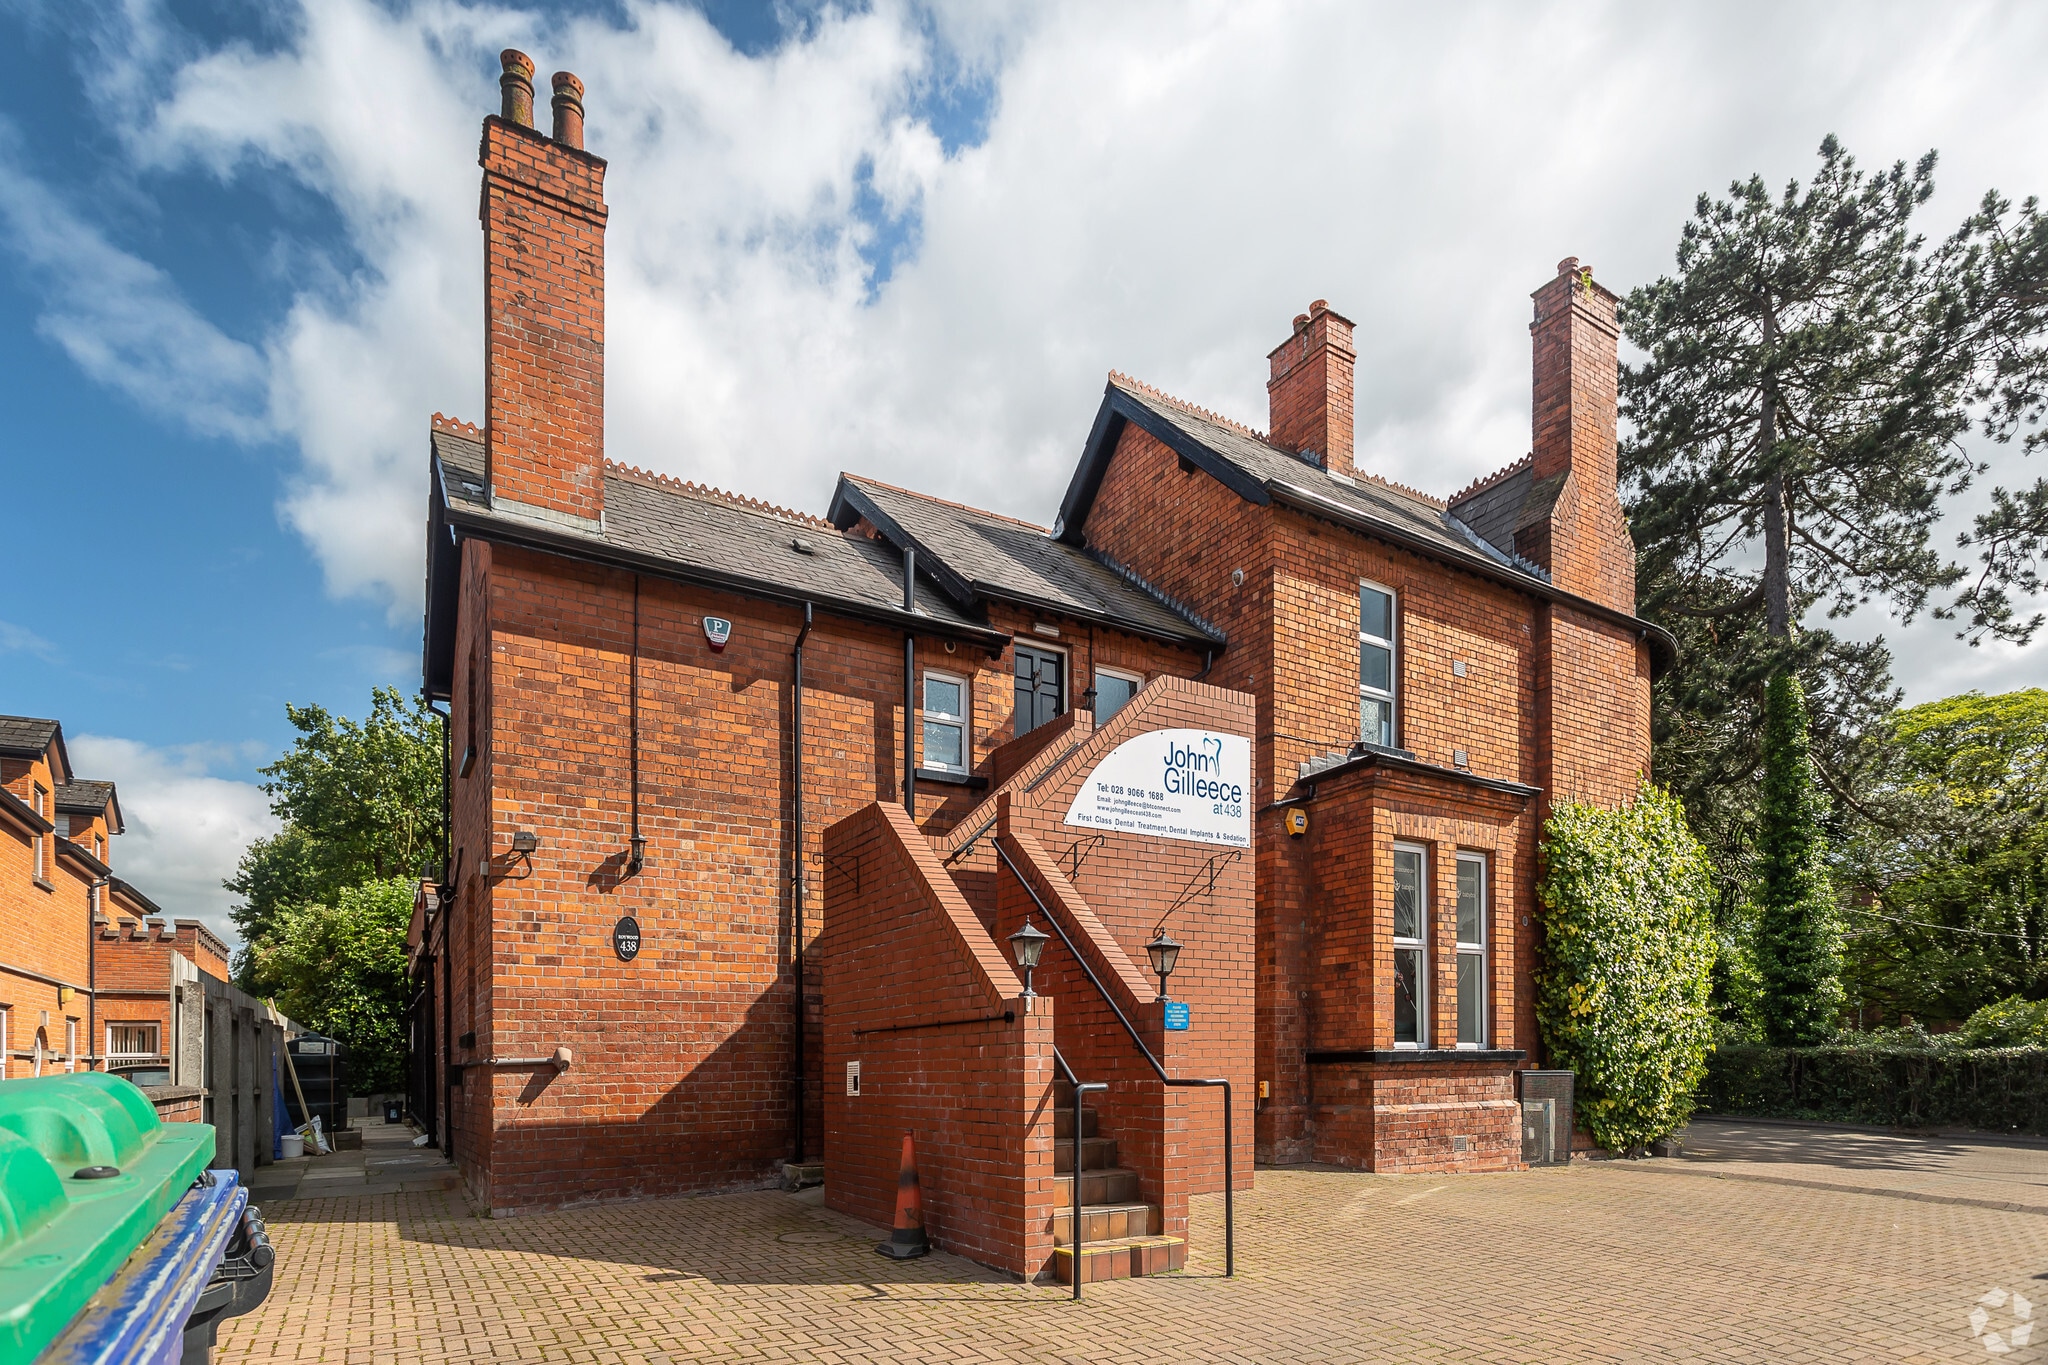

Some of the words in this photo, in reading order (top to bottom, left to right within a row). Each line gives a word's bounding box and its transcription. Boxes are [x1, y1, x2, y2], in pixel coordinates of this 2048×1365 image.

[713, 620, 723, 632] P
[1163, 741, 1208, 772] John
[1097, 782, 1110, 793] Tel:
[1110, 785, 1124, 795] 028
[1127, 787, 1145, 798] 9066
[1148, 790, 1164, 801] 1688
[1164, 767, 1242, 804] Gilleece
[1077, 813, 1092, 822] First
[1095, 815, 1112, 825] Class
[1115, 818, 1135, 828] Dental
[1169, 825, 1188, 835] Dental
[1190, 828, 1214, 838] Implants
[1223, 833, 1247, 843] Sedation
[620, 941, 636, 952] 438
